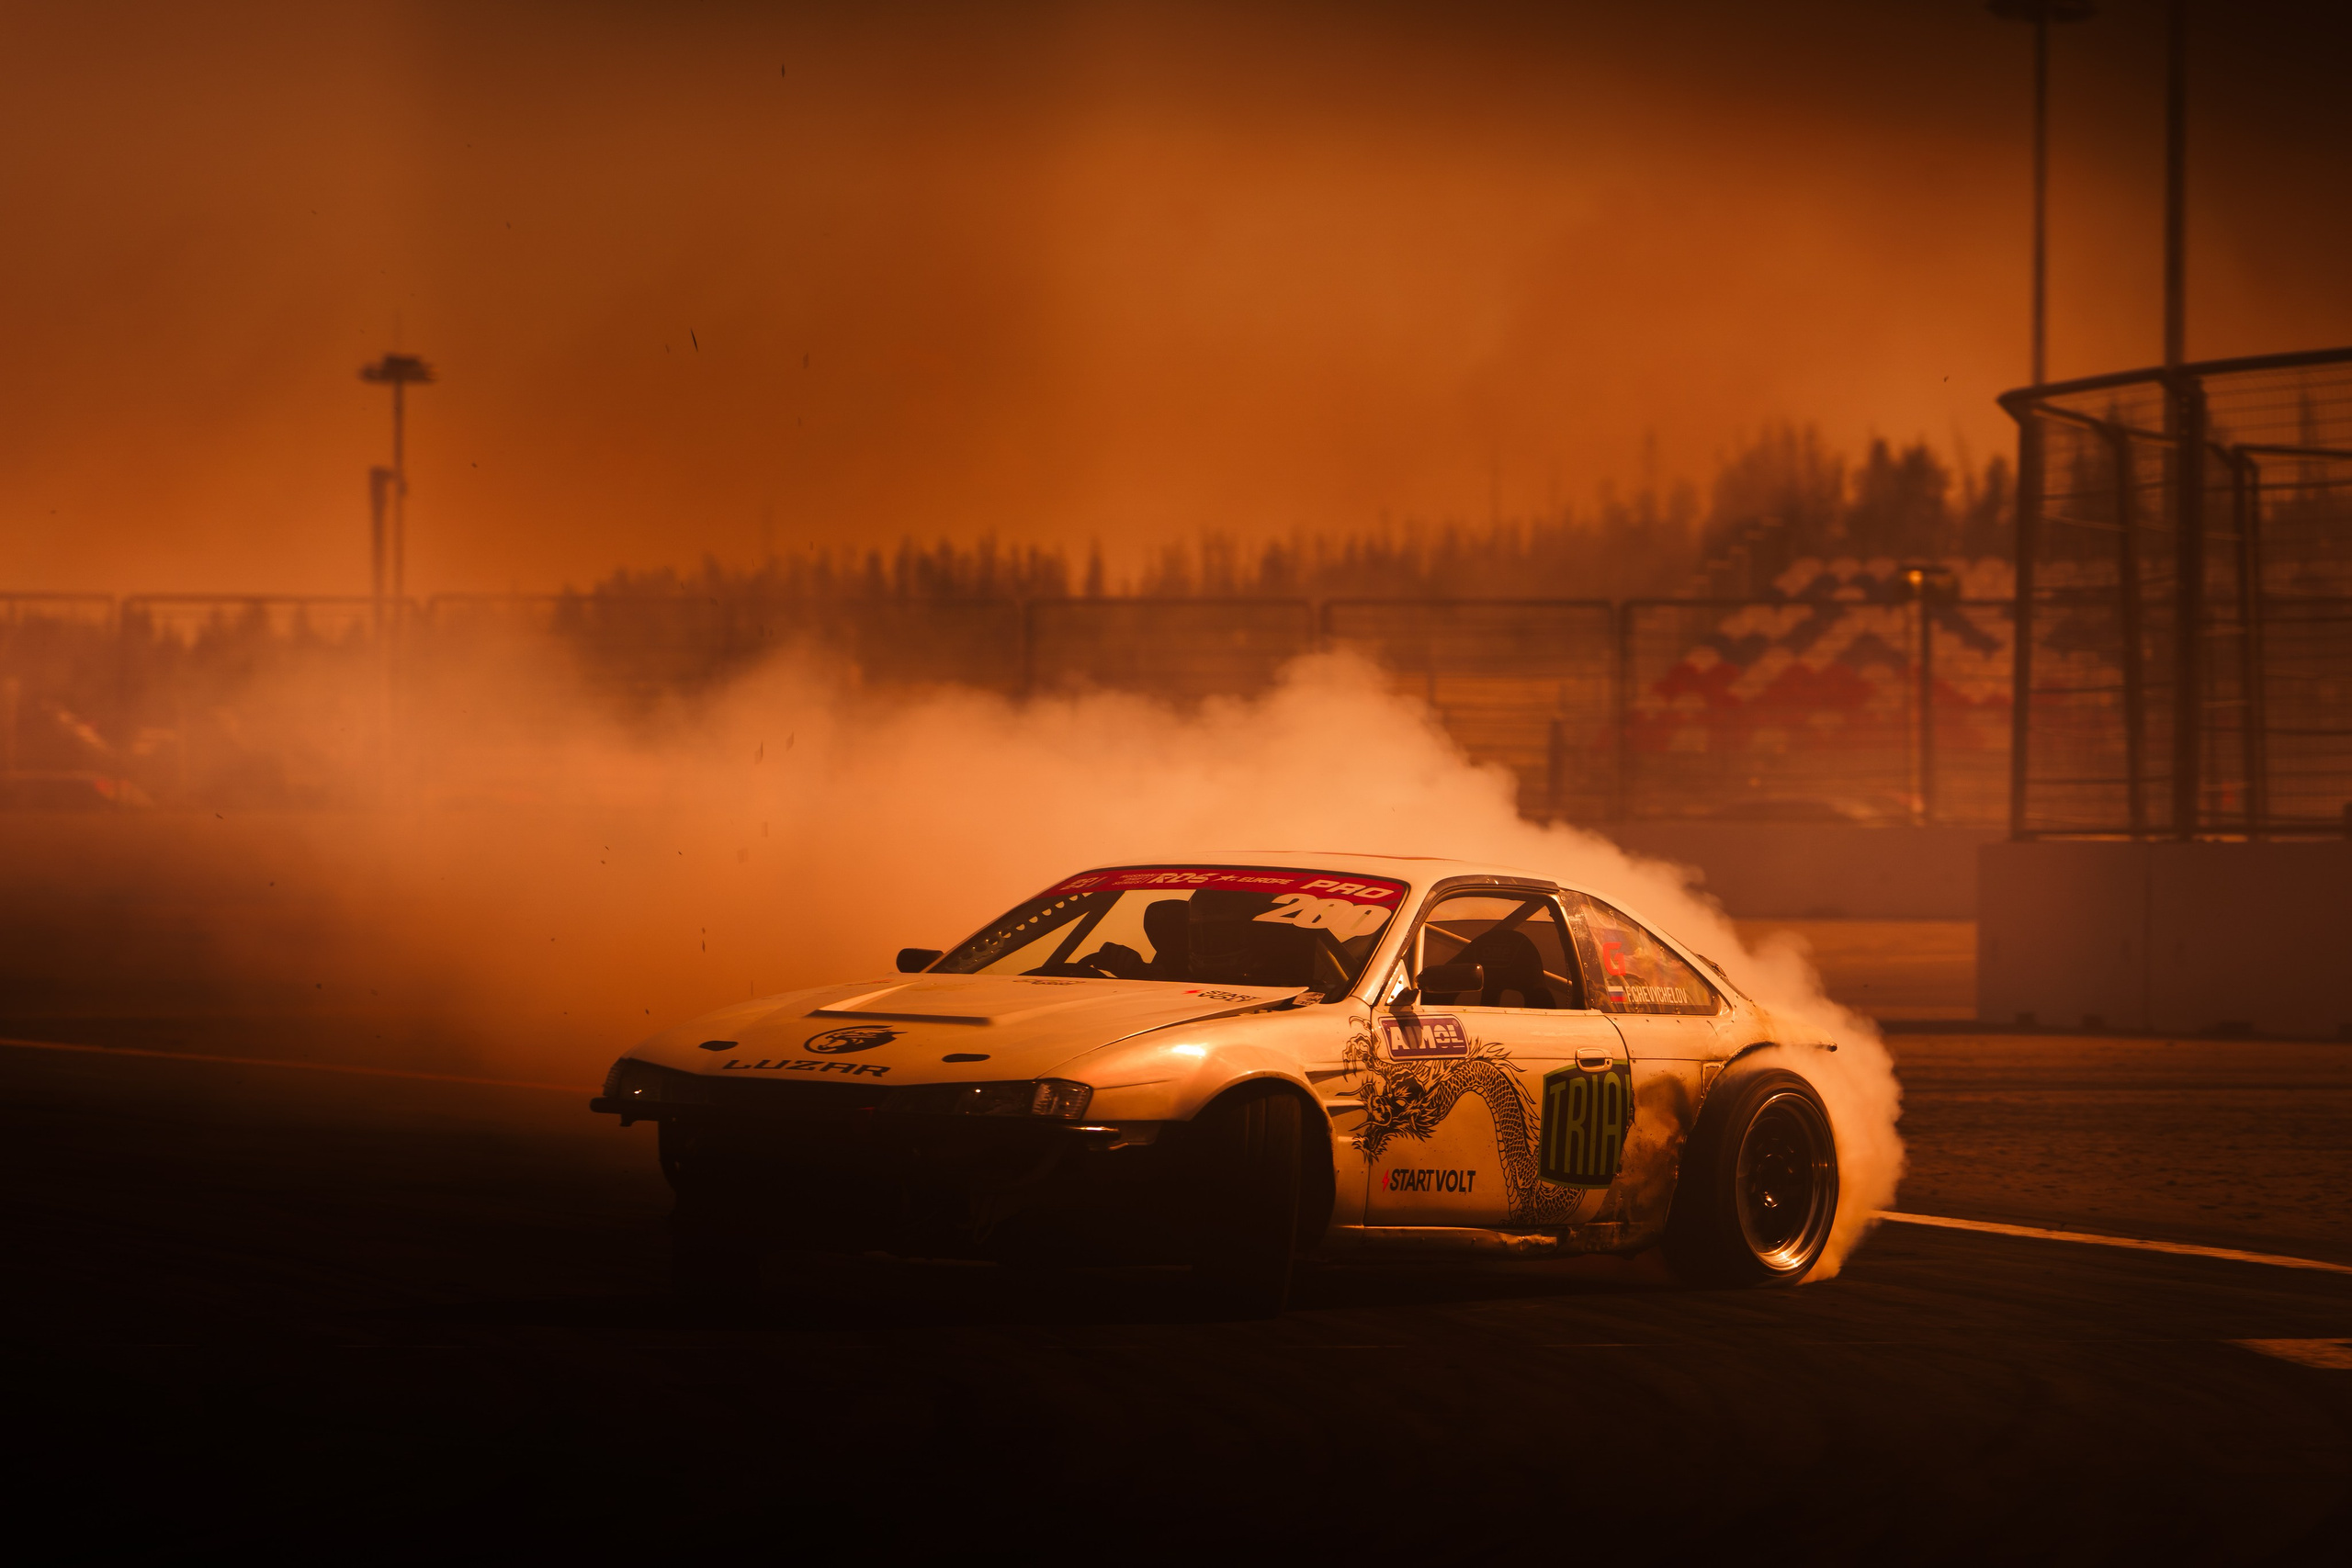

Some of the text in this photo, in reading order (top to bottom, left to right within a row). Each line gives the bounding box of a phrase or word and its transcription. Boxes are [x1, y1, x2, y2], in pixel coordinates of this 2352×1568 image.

[1238, 876, 1295, 886] EUROPE
[1299, 879, 1395, 899] PRO
[1390, 1024, 1465, 1051] AIMOL
[722, 1059, 891, 1077] LUZAR
